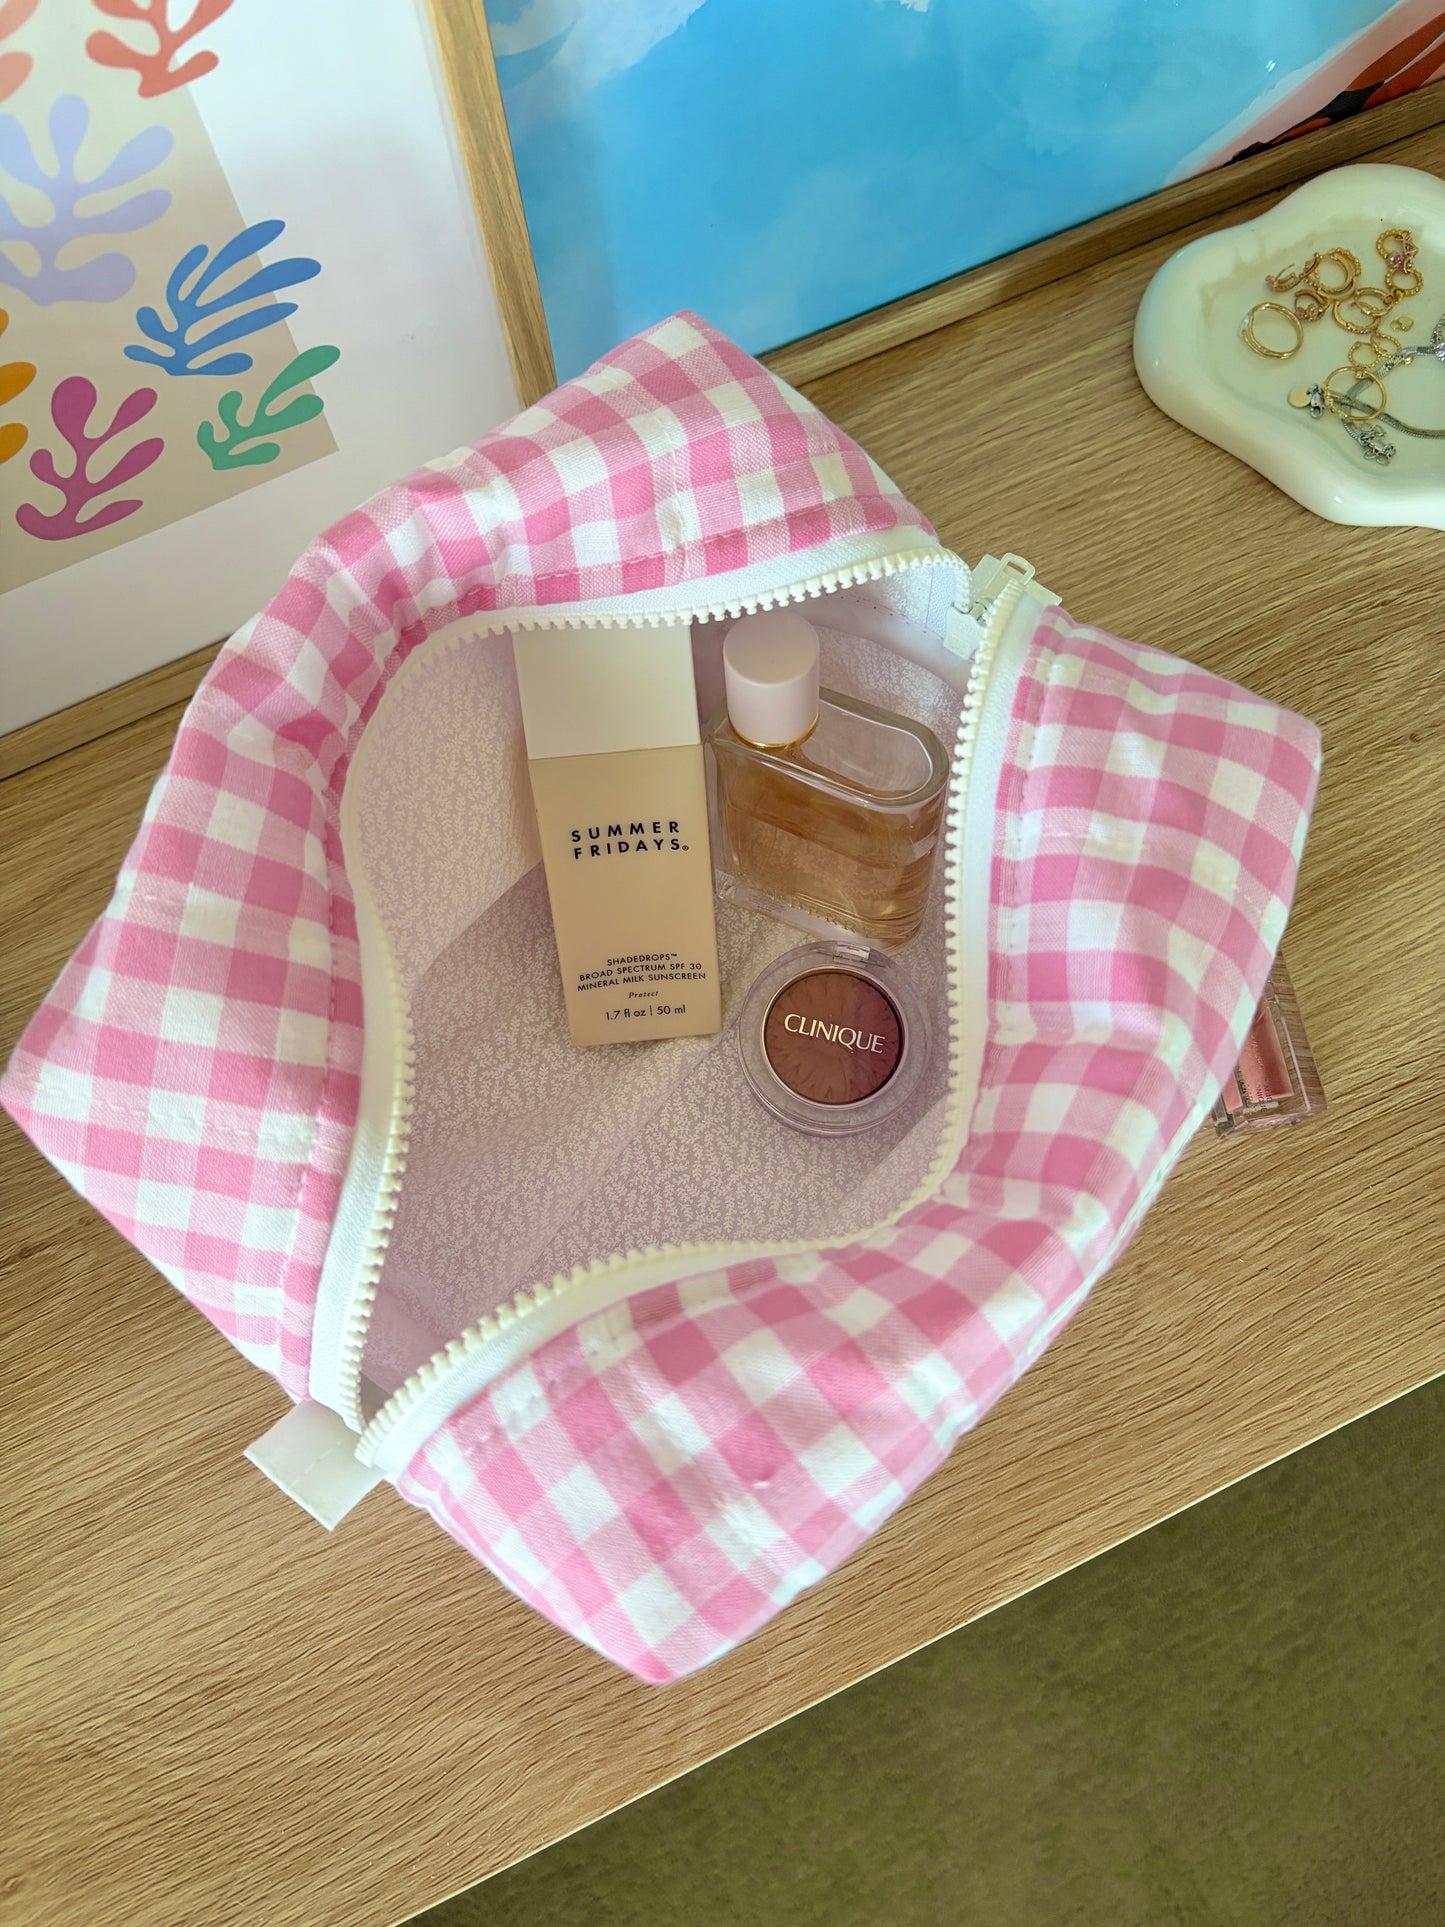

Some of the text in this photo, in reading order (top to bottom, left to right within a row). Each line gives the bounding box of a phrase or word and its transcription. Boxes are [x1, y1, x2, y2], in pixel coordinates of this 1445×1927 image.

[571, 821, 680, 843] SUMMER
[577, 972, 707, 992] MINERAL MILK SUNSCREEN
[579, 962, 702, 982] BROAD SPECTRUM SPF 30
[628, 991, 659, 999] Protect
[606, 1010, 621, 1021] 1.7
[624, 1008, 631, 1018] fl
[633, 1009, 647, 1017] oz
[656, 1005, 671, 1016] 50
[674, 1004, 686, 1014] ml
[784, 1013, 886, 1054] CLINIQUE
